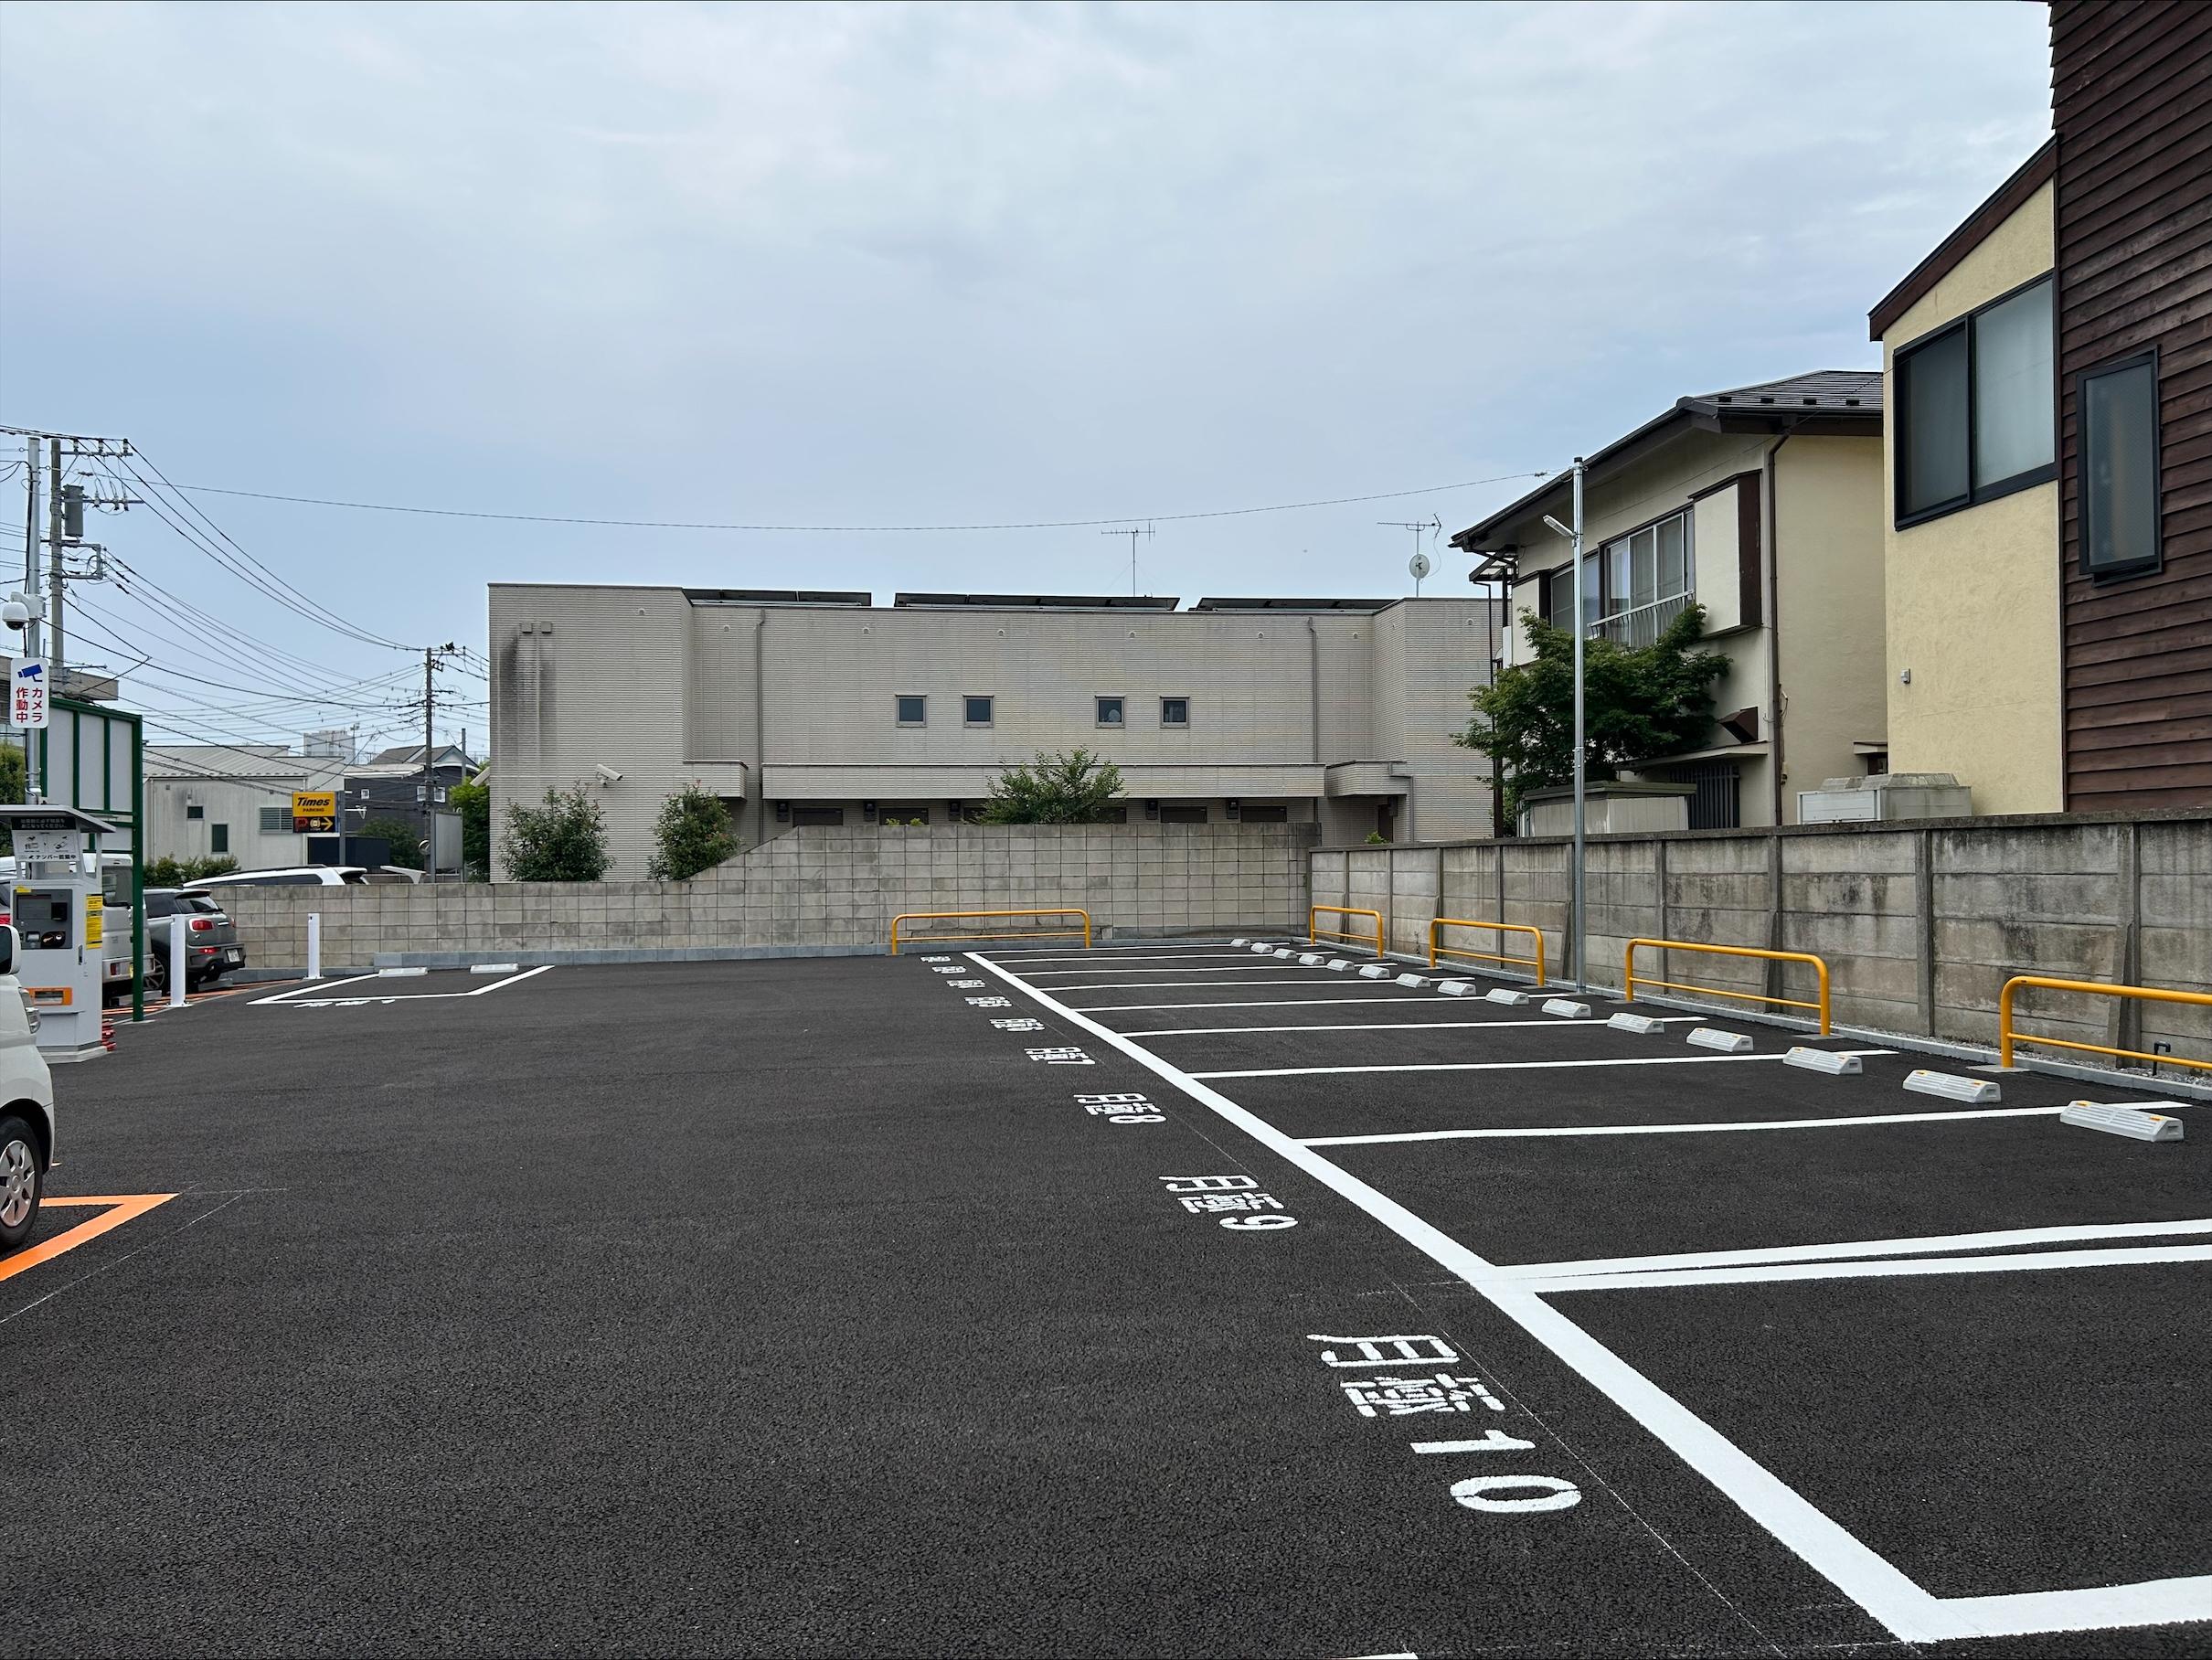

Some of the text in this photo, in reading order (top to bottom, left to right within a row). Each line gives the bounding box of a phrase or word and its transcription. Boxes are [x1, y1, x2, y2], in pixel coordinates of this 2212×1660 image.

[16, 687, 28, 723] 作動中
[32, 687, 43, 723] カメラ
[297, 796, 331, 806] Times
